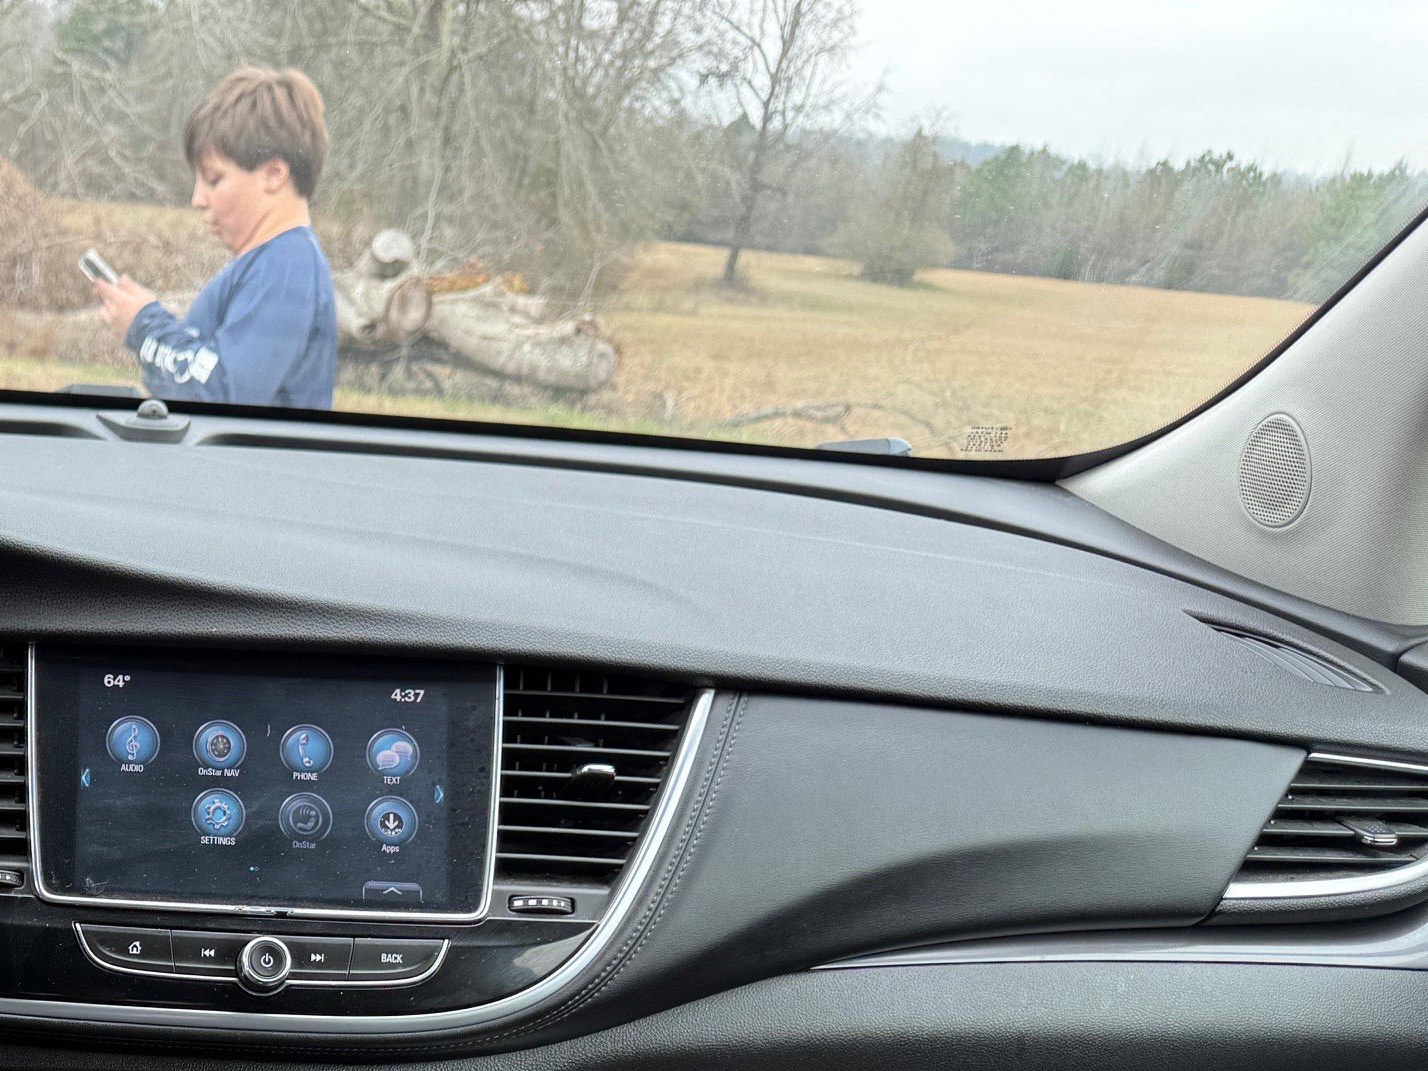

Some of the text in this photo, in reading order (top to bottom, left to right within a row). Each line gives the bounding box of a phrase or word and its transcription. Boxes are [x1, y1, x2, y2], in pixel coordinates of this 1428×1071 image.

[391, 688, 425, 703] 4:37
[121, 764, 144, 773] AUDIO
[198, 767, 240, 777] OnStar NAV
[292, 771, 318, 781] PHONE
[383, 776, 401, 785] TEXT
[200, 836, 235, 846] SETTINGS
[292, 840, 317, 850] OnStar
[381, 844, 400, 854] Apps
[381, 953, 403, 964] BACK
